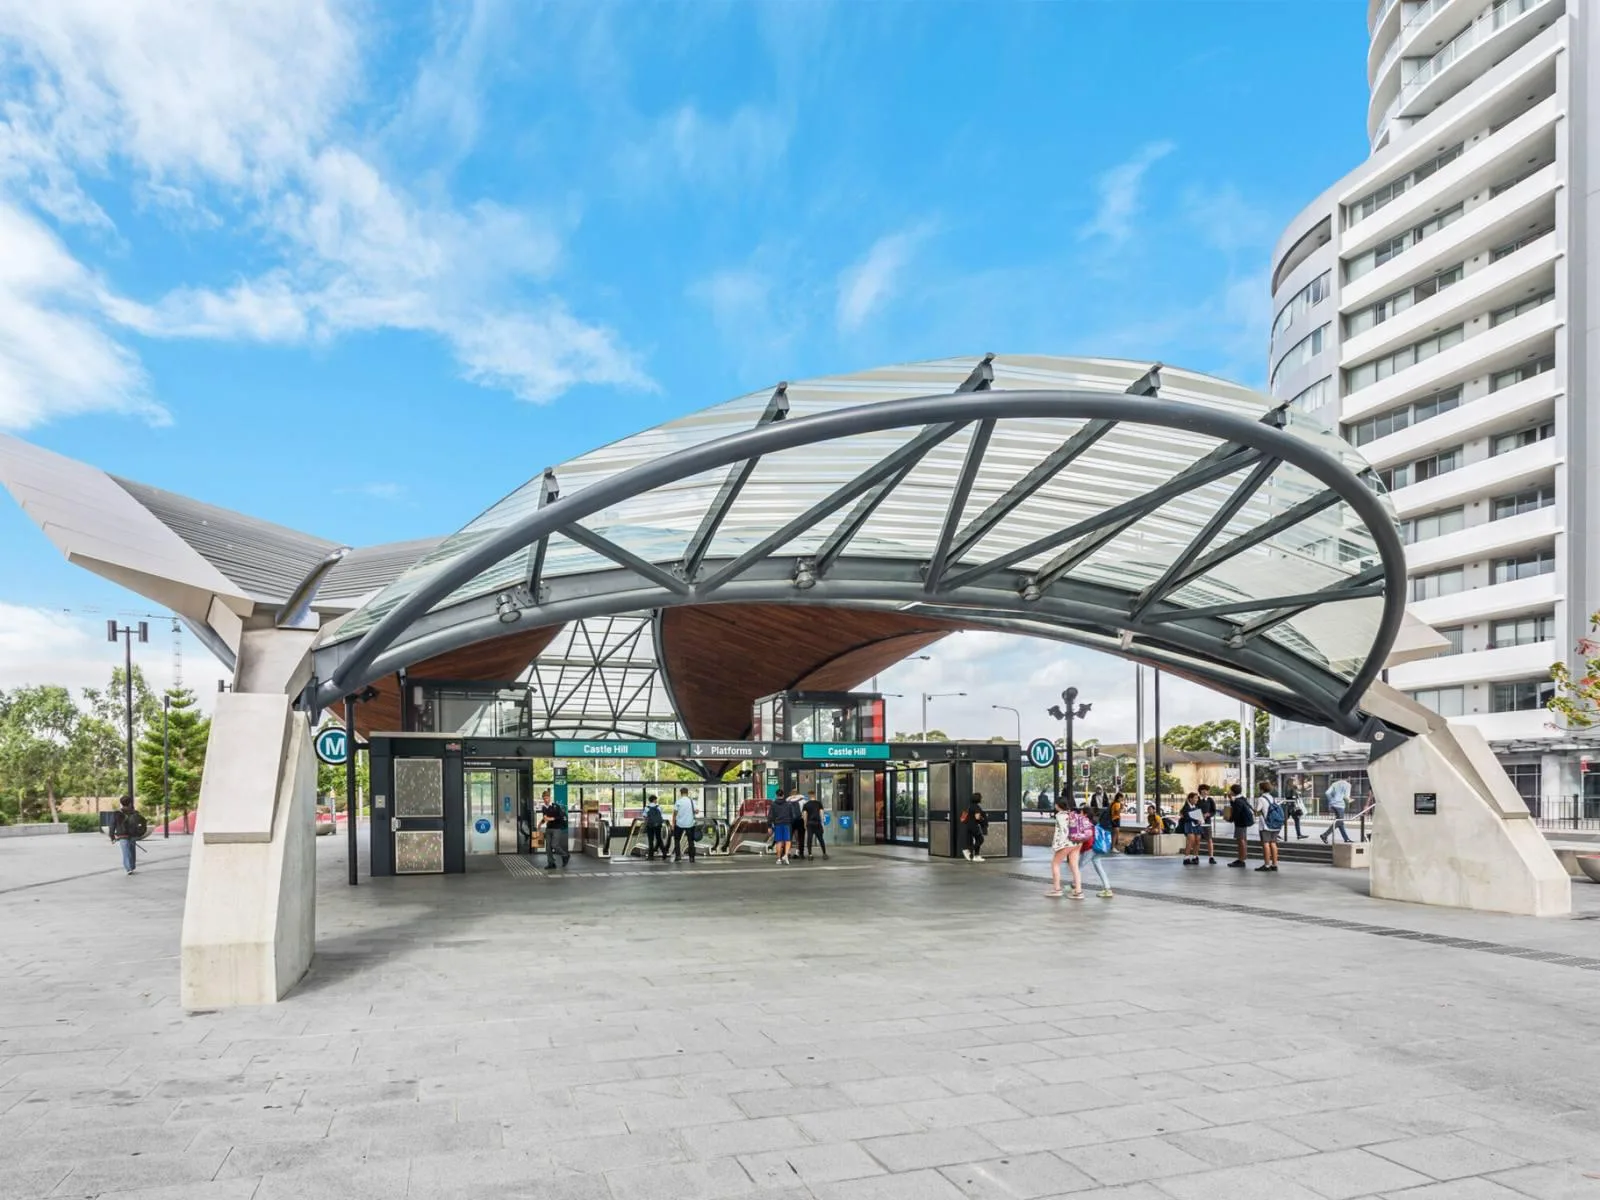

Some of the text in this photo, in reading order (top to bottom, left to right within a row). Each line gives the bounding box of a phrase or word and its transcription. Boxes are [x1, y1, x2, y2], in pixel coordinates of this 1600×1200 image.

[325, 737, 345, 756] M
[583, 744, 629, 754] Castle Hill
[711, 746, 752, 755] Platforms
[828, 747, 867, 756] Castle Hill
[1036, 745, 1049, 761] M
